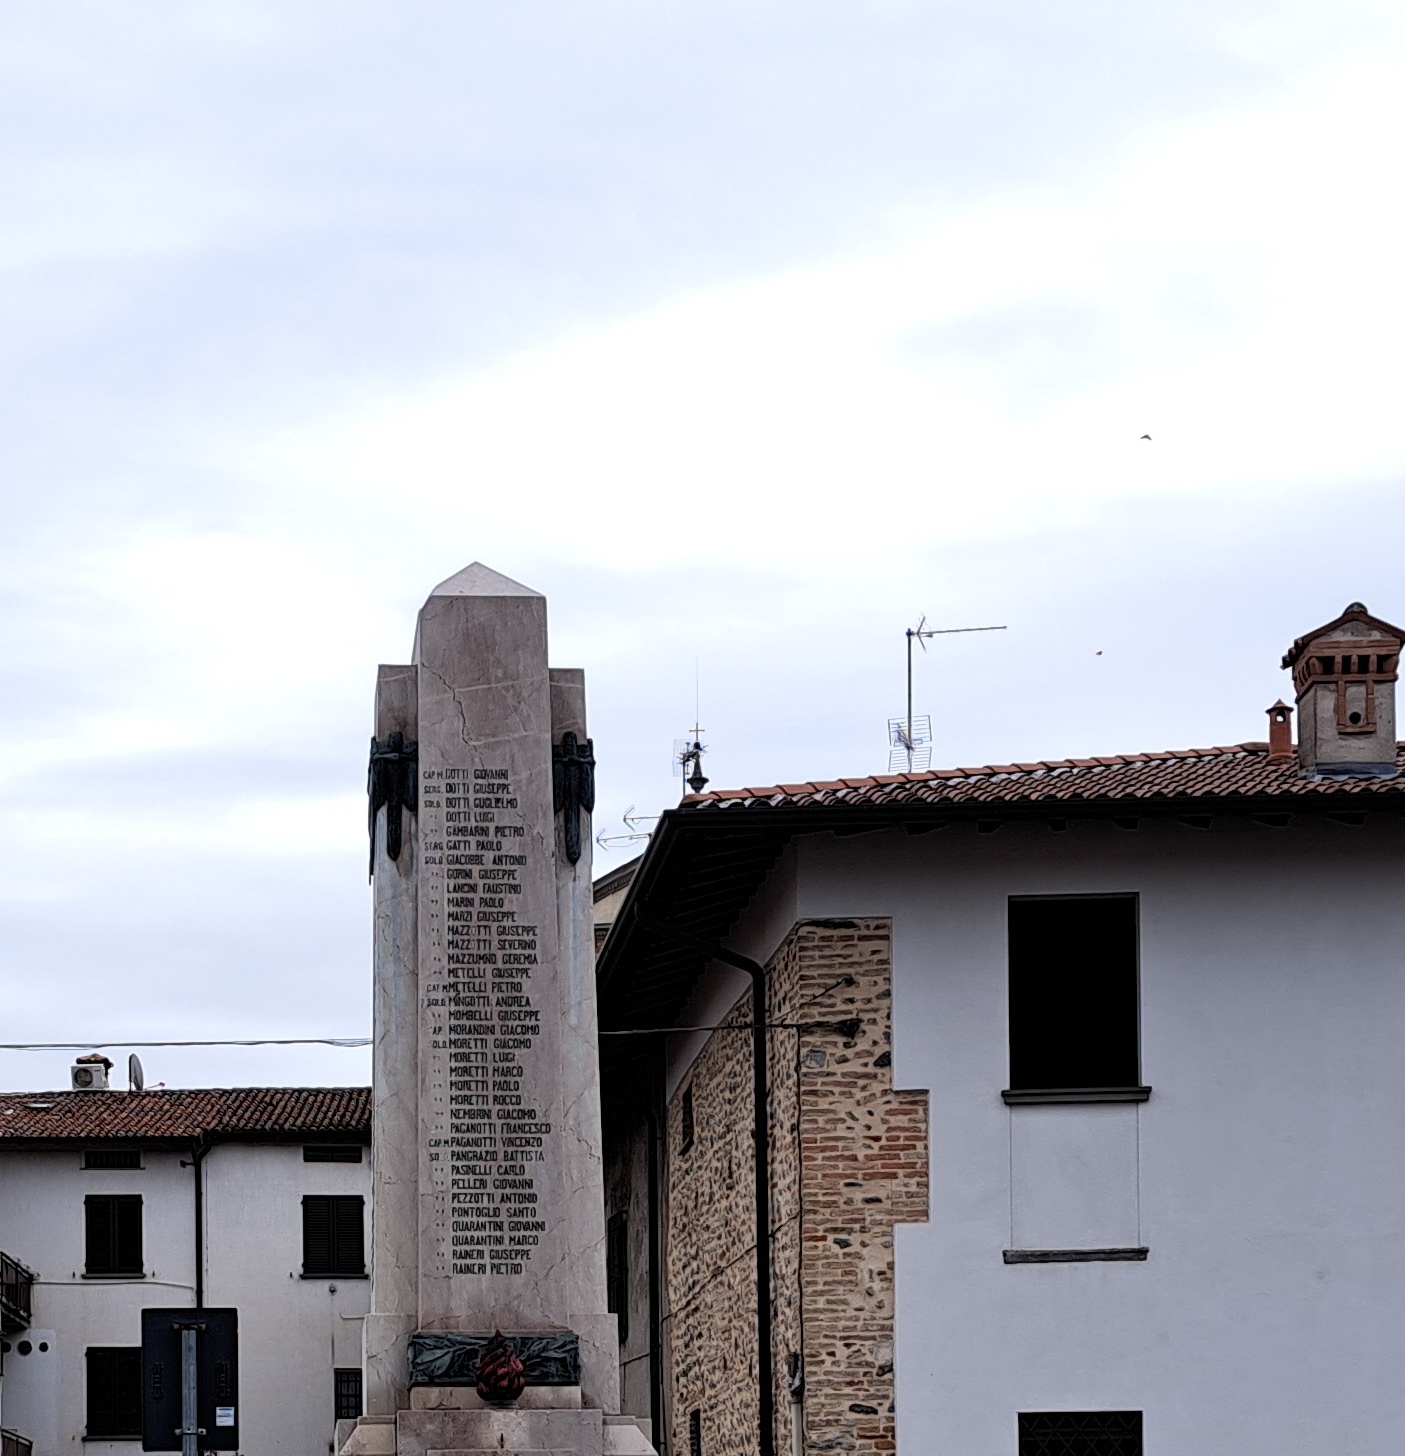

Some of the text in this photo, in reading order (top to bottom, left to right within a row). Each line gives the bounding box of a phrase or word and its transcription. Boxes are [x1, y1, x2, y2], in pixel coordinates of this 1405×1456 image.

[474, 783, 512, 794] GIUSEPPE
[446, 798, 469, 808] DOTTI
[446, 811, 470, 822] DOTTI
[495, 826, 524, 837] PIETRO
[447, 840, 502, 851] GATTI PAOLO
[492, 855, 527, 866] ANTONIO
[479, 869, 517, 880] GIUSEPPE
[479, 897, 504, 908] PAOLO
[477, 911, 517, 922] GIUSEPPE
[497, 926, 538, 936] GIUSEPPE
[497, 939, 536, 950] SEVERINO
[492, 968, 531, 979] GIUSEPPE
[492, 982, 522, 993] PIETRO
[498, 1010, 540, 1021] GIUSEPPE
[500, 1024, 539, 1035] GIACOMO
[449, 1038, 531, 1049] MORETTI GIACOMO
[450, 1052, 487, 1063] MORETTI
[450, 1067, 488, 1077] MORETTI
[450, 1080, 519, 1091] MORETTI PAOLO
[450, 1095, 489, 1105] MORETTI
[497, 1110, 536, 1119] GIACOMO
[451, 1124, 496, 1134] PAGANOTTI
[451, 1137, 496, 1148] PAGANOTTI
[504, 1151, 544, 1161] BATTISTA
[497, 1165, 525, 1175] CARLO
[494, 1179, 533, 1189] GIOVANNI
[452, 1193, 537, 1203] PEZZOTTI ANTONIO
[507, 1207, 536, 1218] SANTO
[509, 1221, 545, 1231] GIOVANNI
[509, 1235, 538, 1246] MARCO
[490, 1250, 531, 1260] GIUSEPPE
[491, 1263, 522, 1275] PIETRO
